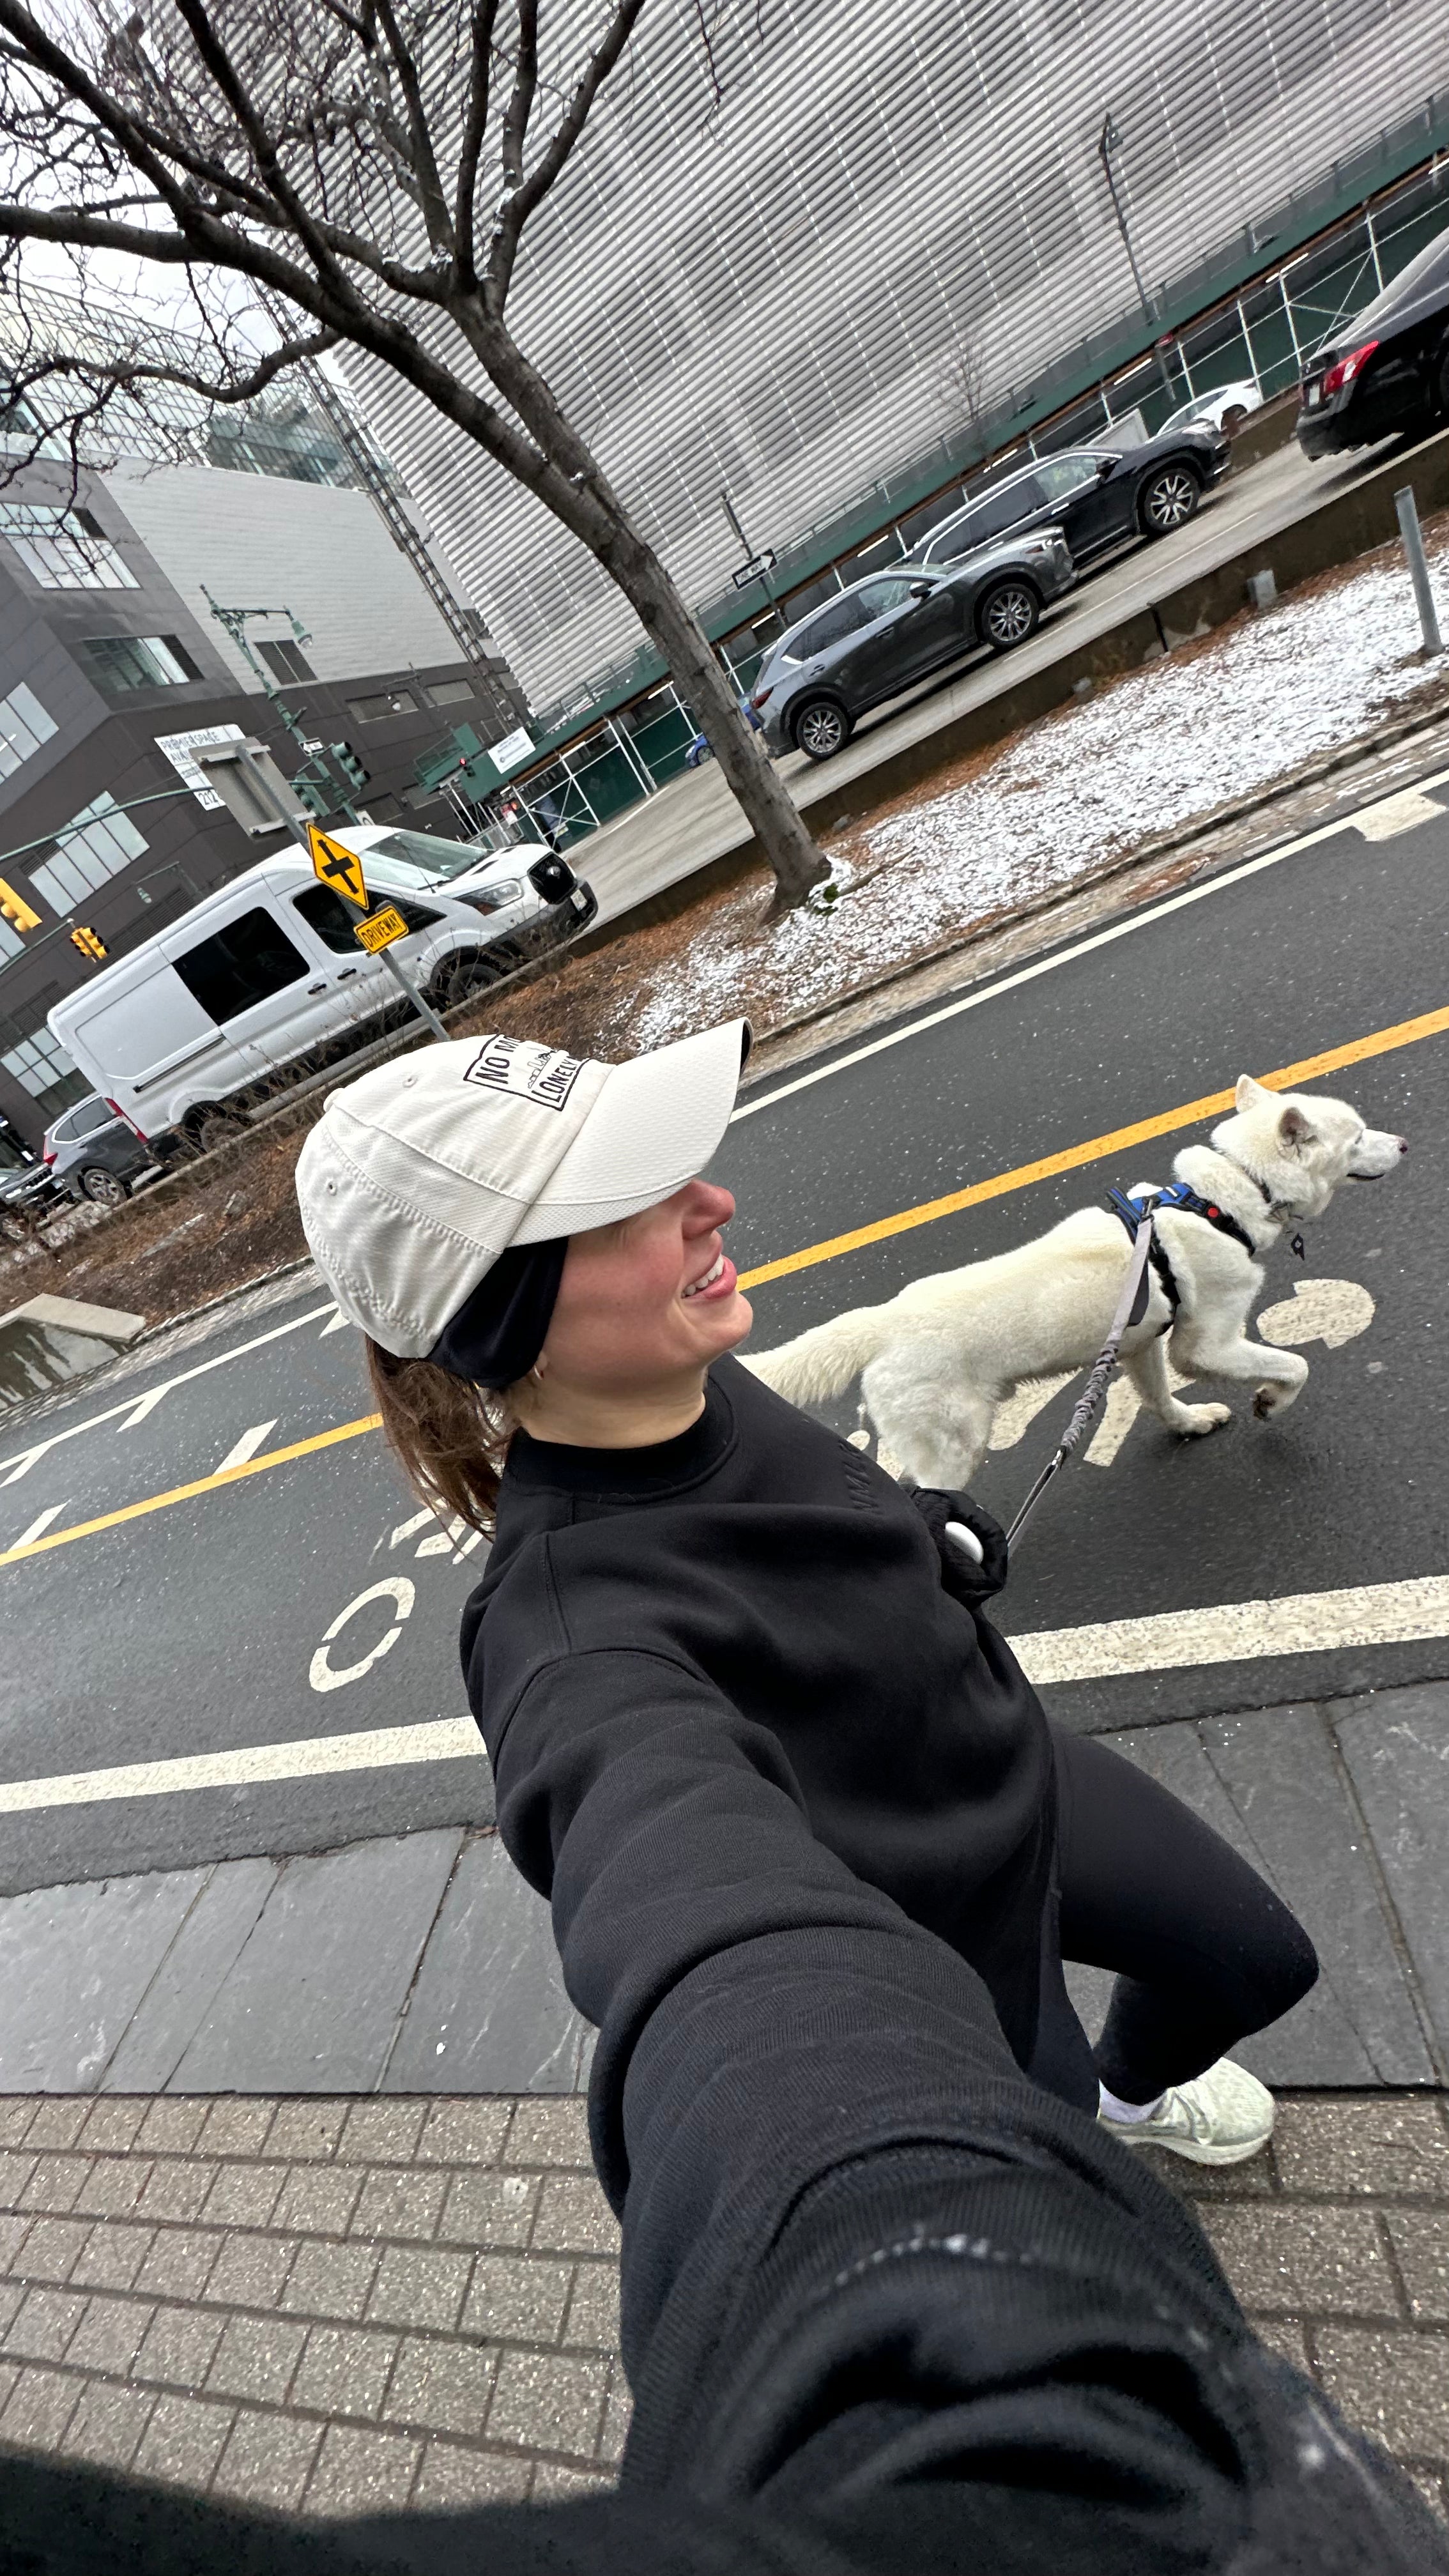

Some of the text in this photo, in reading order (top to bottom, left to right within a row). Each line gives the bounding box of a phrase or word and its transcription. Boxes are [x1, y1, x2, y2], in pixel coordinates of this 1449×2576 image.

[194, 732, 220, 745] SPACE
[198, 790, 218, 806] 212
[361, 913, 402, 947] DRIVEWAY
[475, 1057, 510, 1084] NO
[531, 1059, 578, 1103] LONELY
